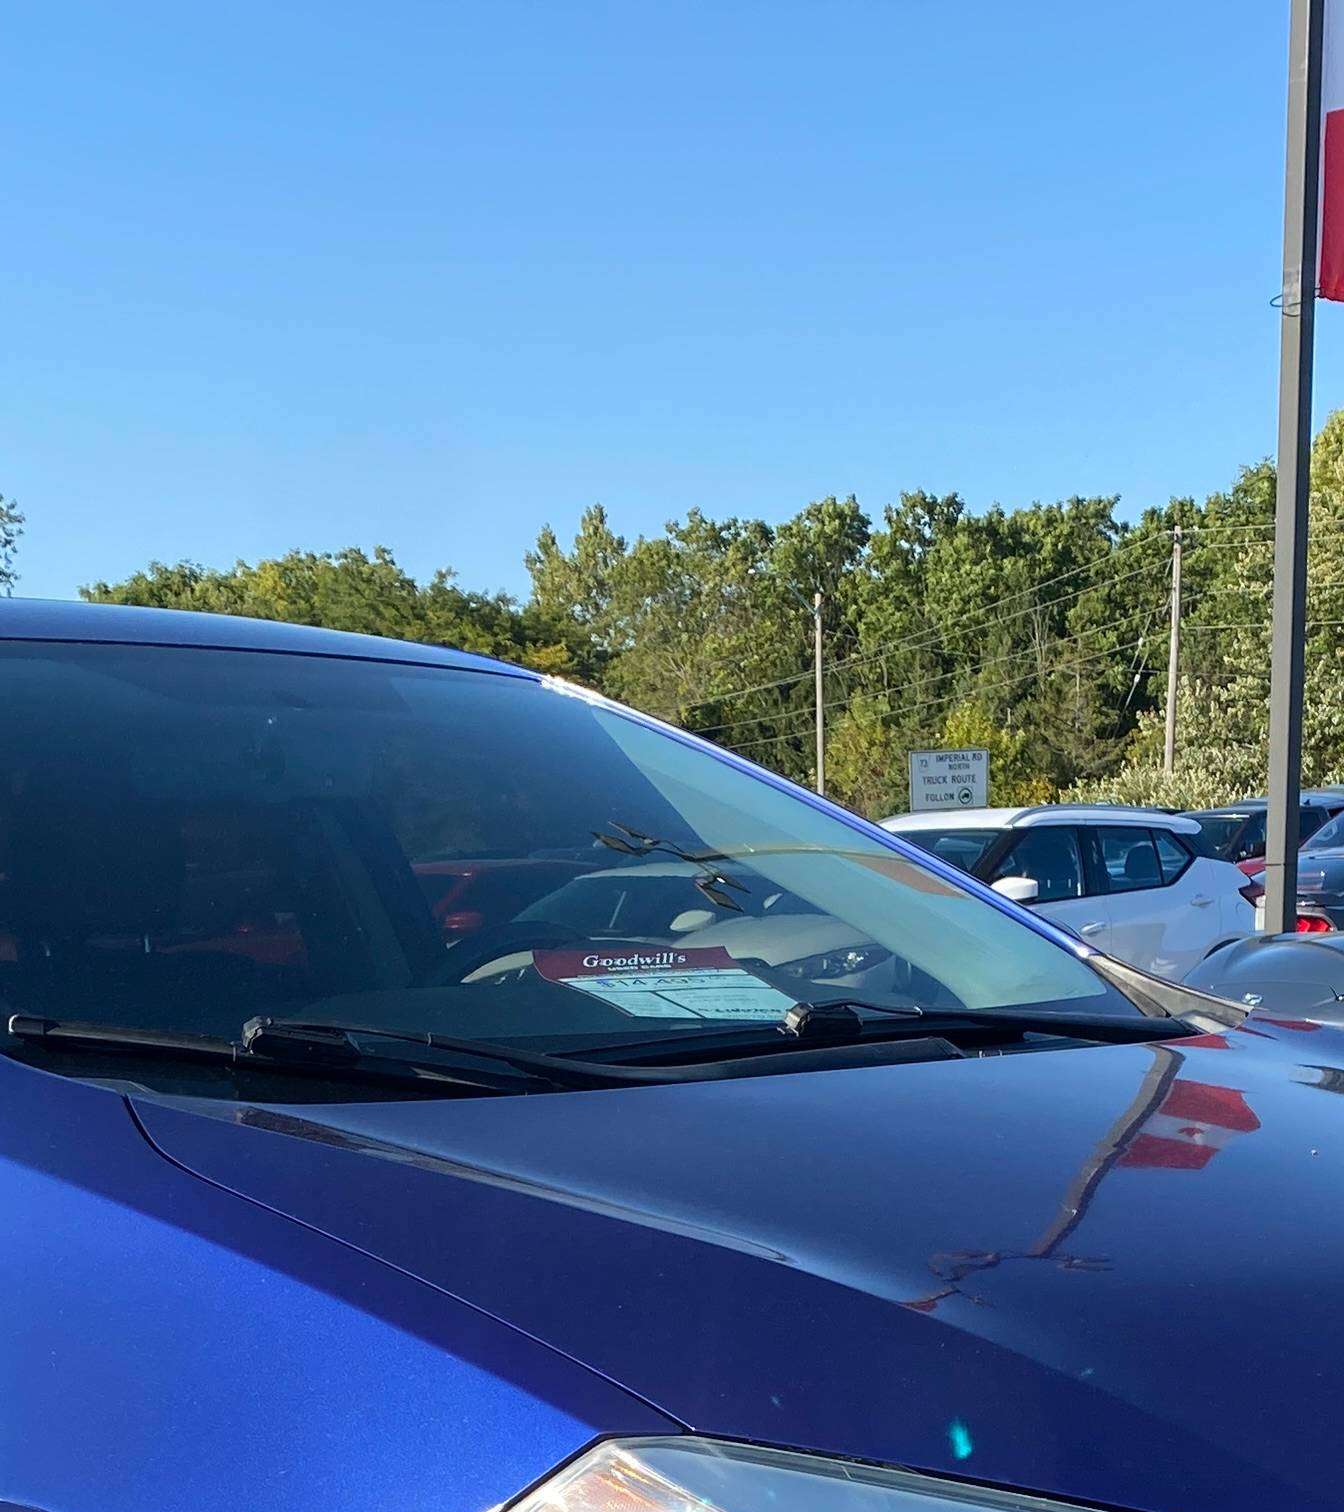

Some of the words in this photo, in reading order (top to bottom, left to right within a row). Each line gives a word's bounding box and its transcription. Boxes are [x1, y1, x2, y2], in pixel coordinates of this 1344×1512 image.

[935, 753, 970, 762] IMPERIAL
[922, 776, 948, 785] TRUCK
[951, 774, 977, 784] ROUTE
[582, 952, 688, 969] Goodwill's
